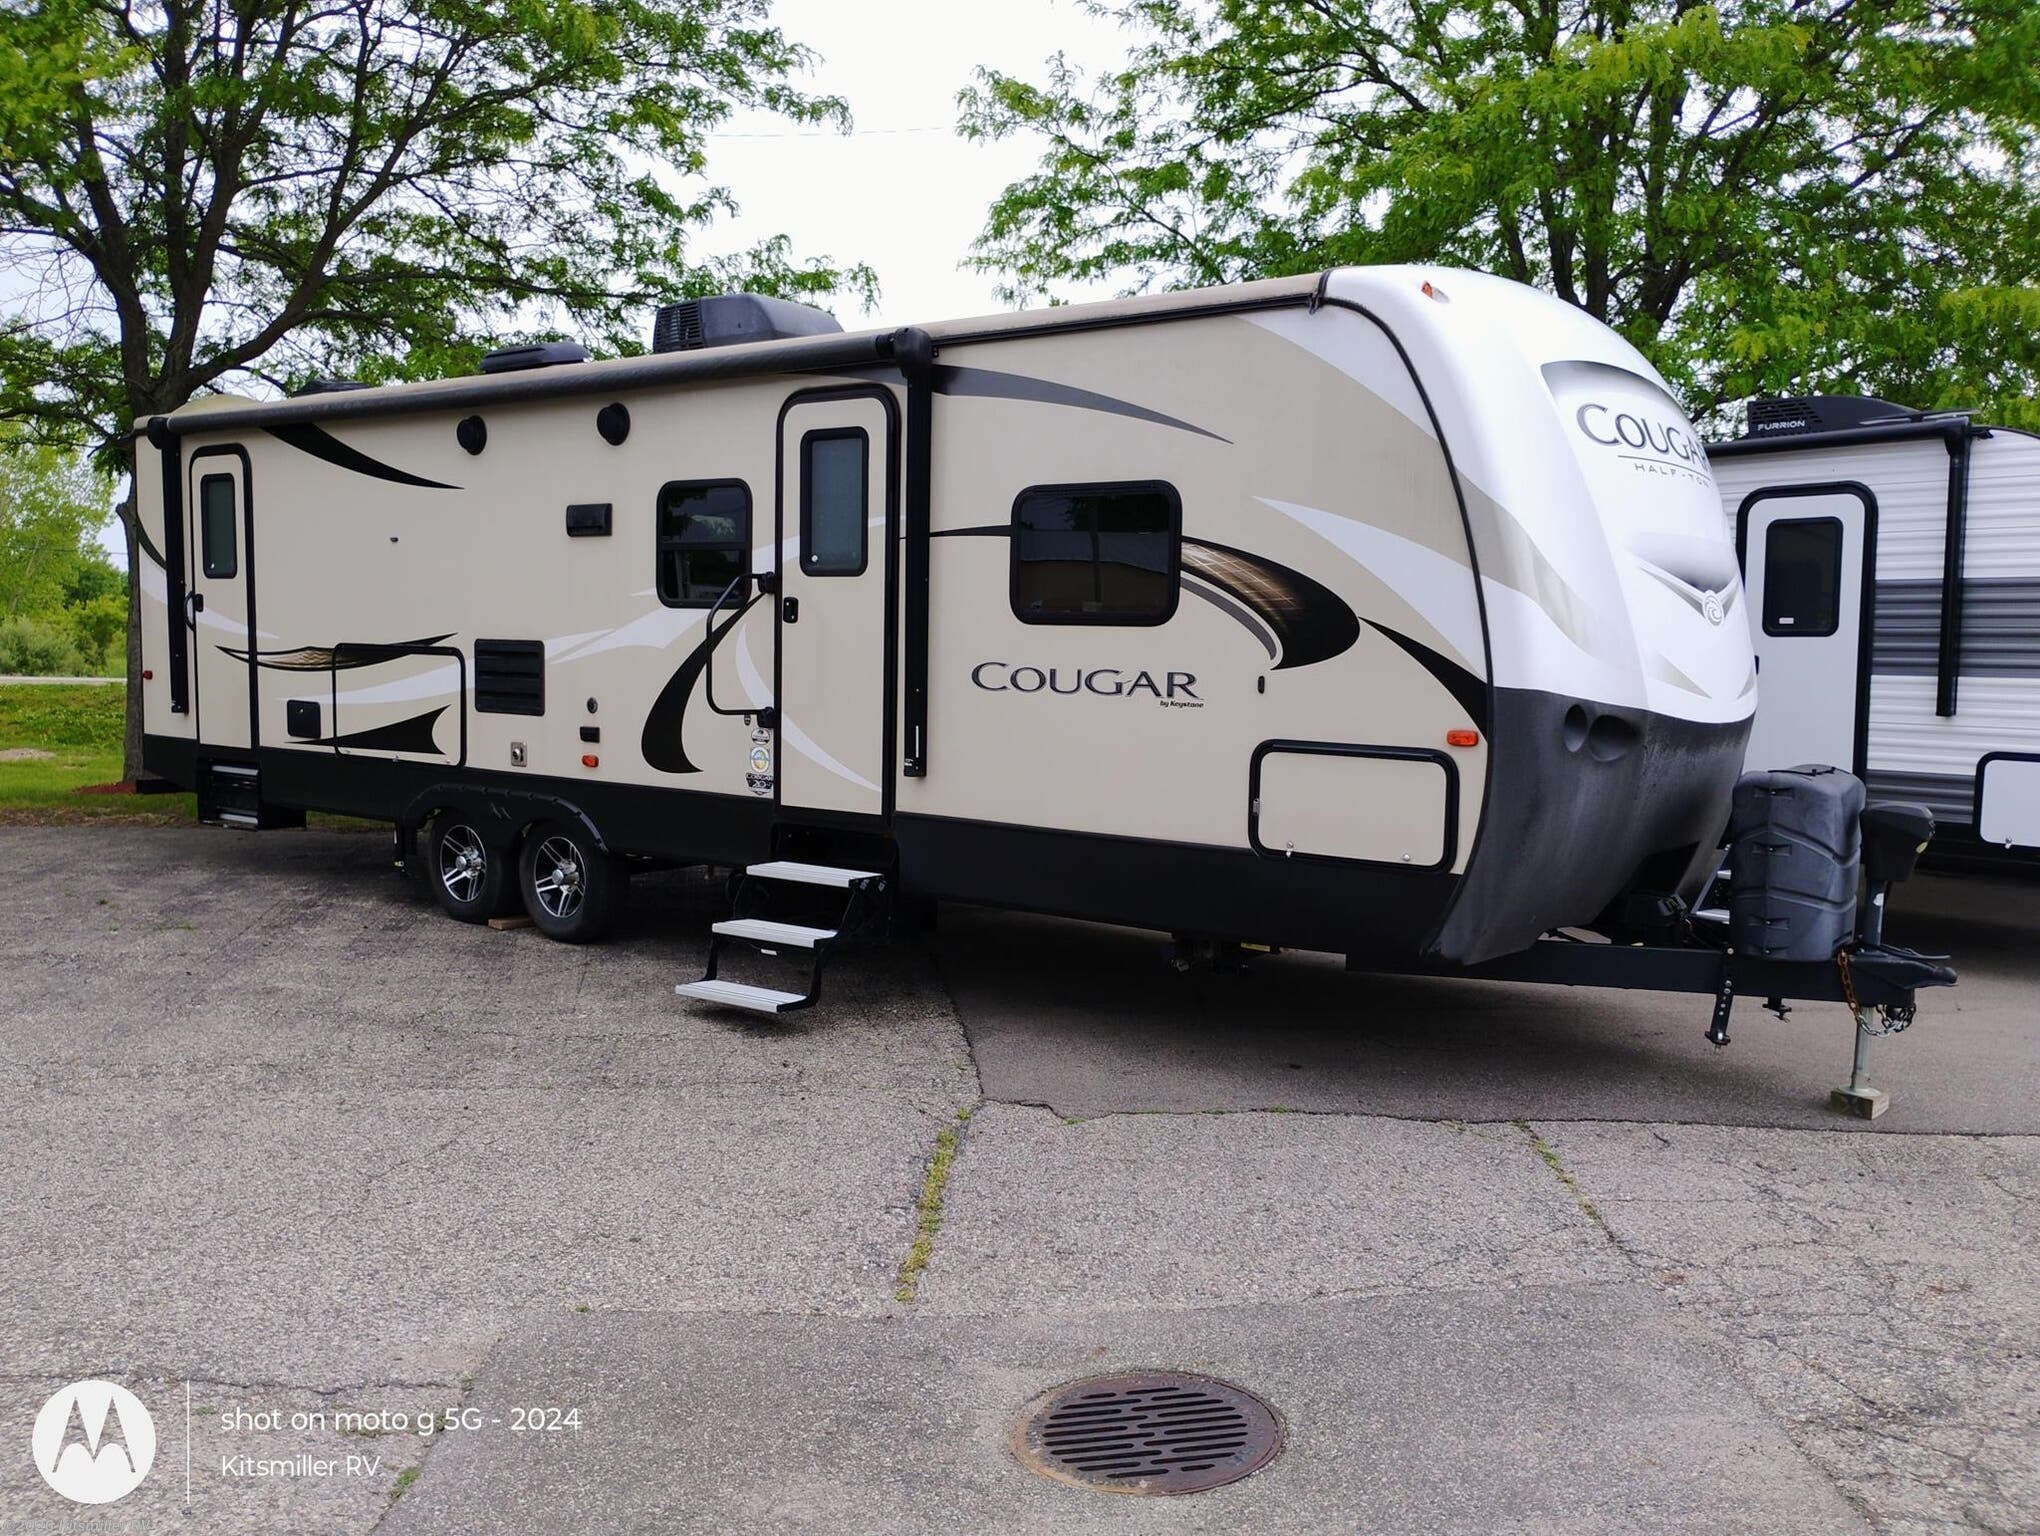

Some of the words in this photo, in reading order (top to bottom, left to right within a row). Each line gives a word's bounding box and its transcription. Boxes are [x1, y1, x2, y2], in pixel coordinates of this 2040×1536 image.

[1757, 420, 1806, 431] FURRION
[970, 661, 1204, 701] COUGAR
[1170, 699, 1204, 708] Keystone
